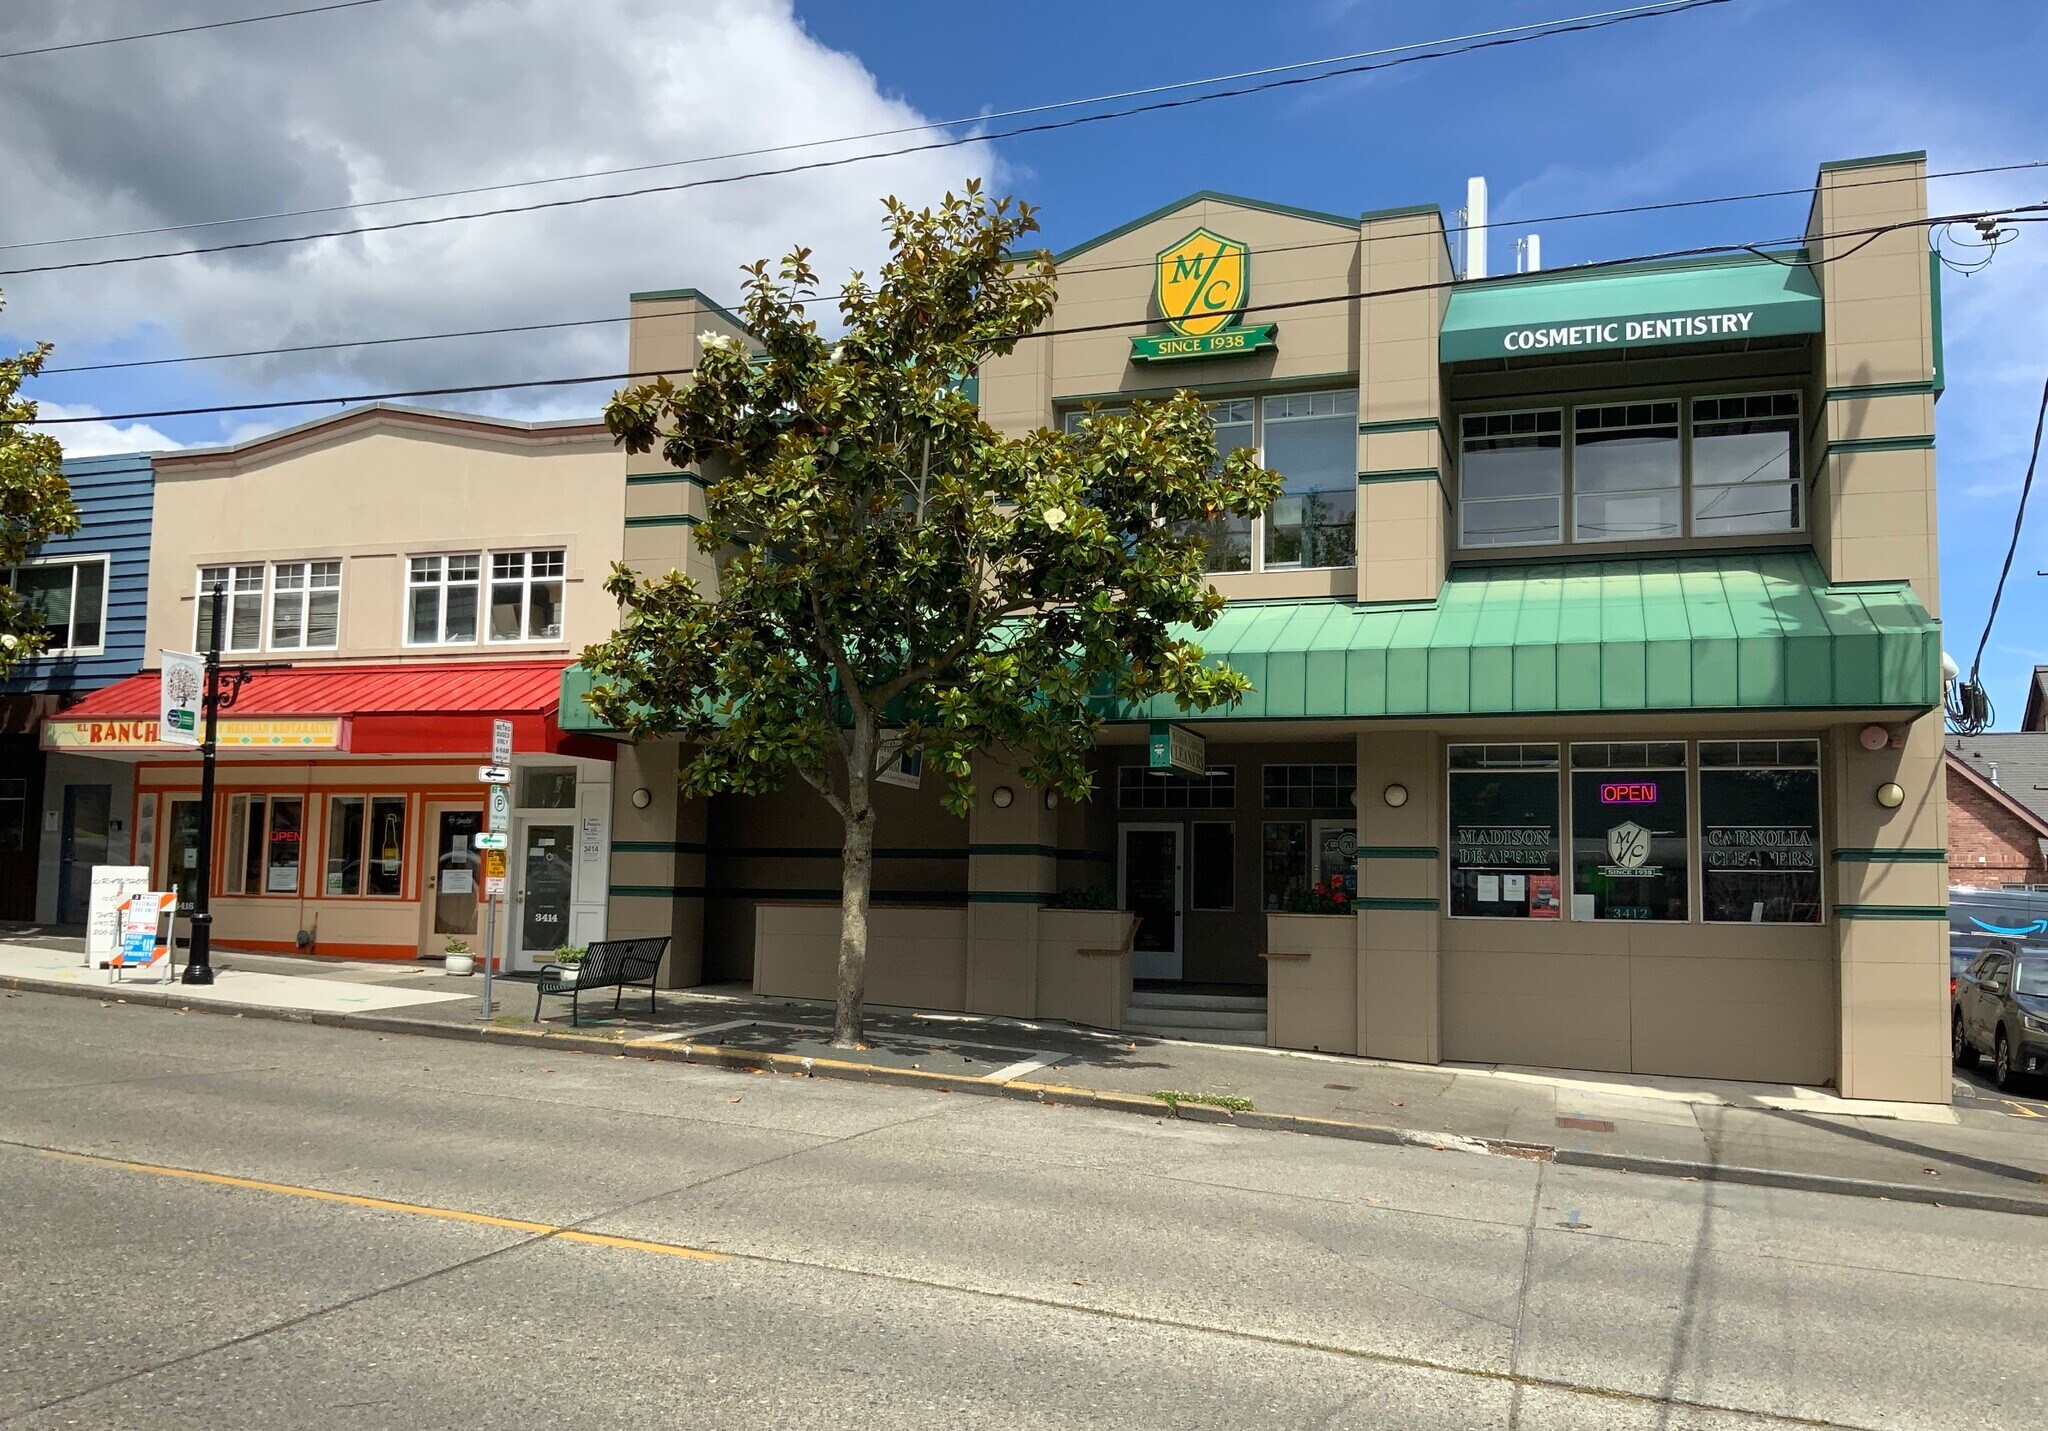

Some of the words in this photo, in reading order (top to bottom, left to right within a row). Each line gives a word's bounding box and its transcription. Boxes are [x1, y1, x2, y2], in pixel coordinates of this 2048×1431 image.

[1503, 323, 1618, 351] COSMETIC
[1625, 311, 1754, 341] DENTISTRY
[1158, 339, 1202, 354] SINCE
[1210, 335, 1245, 349] 1938
[90, 720, 160, 743] RANCH
[1604, 785, 1654, 801] OPEN
[270, 831, 300, 842] OPEN
[1459, 829, 1551, 845] MADISON
[1708, 829, 1813, 847] CARNOLIA
[583, 845, 599, 853] 3414
[1458, 848, 1550, 864] DRAPERY
[535, 913, 558, 922] 3414
[1613, 908, 1648, 919] 3412
